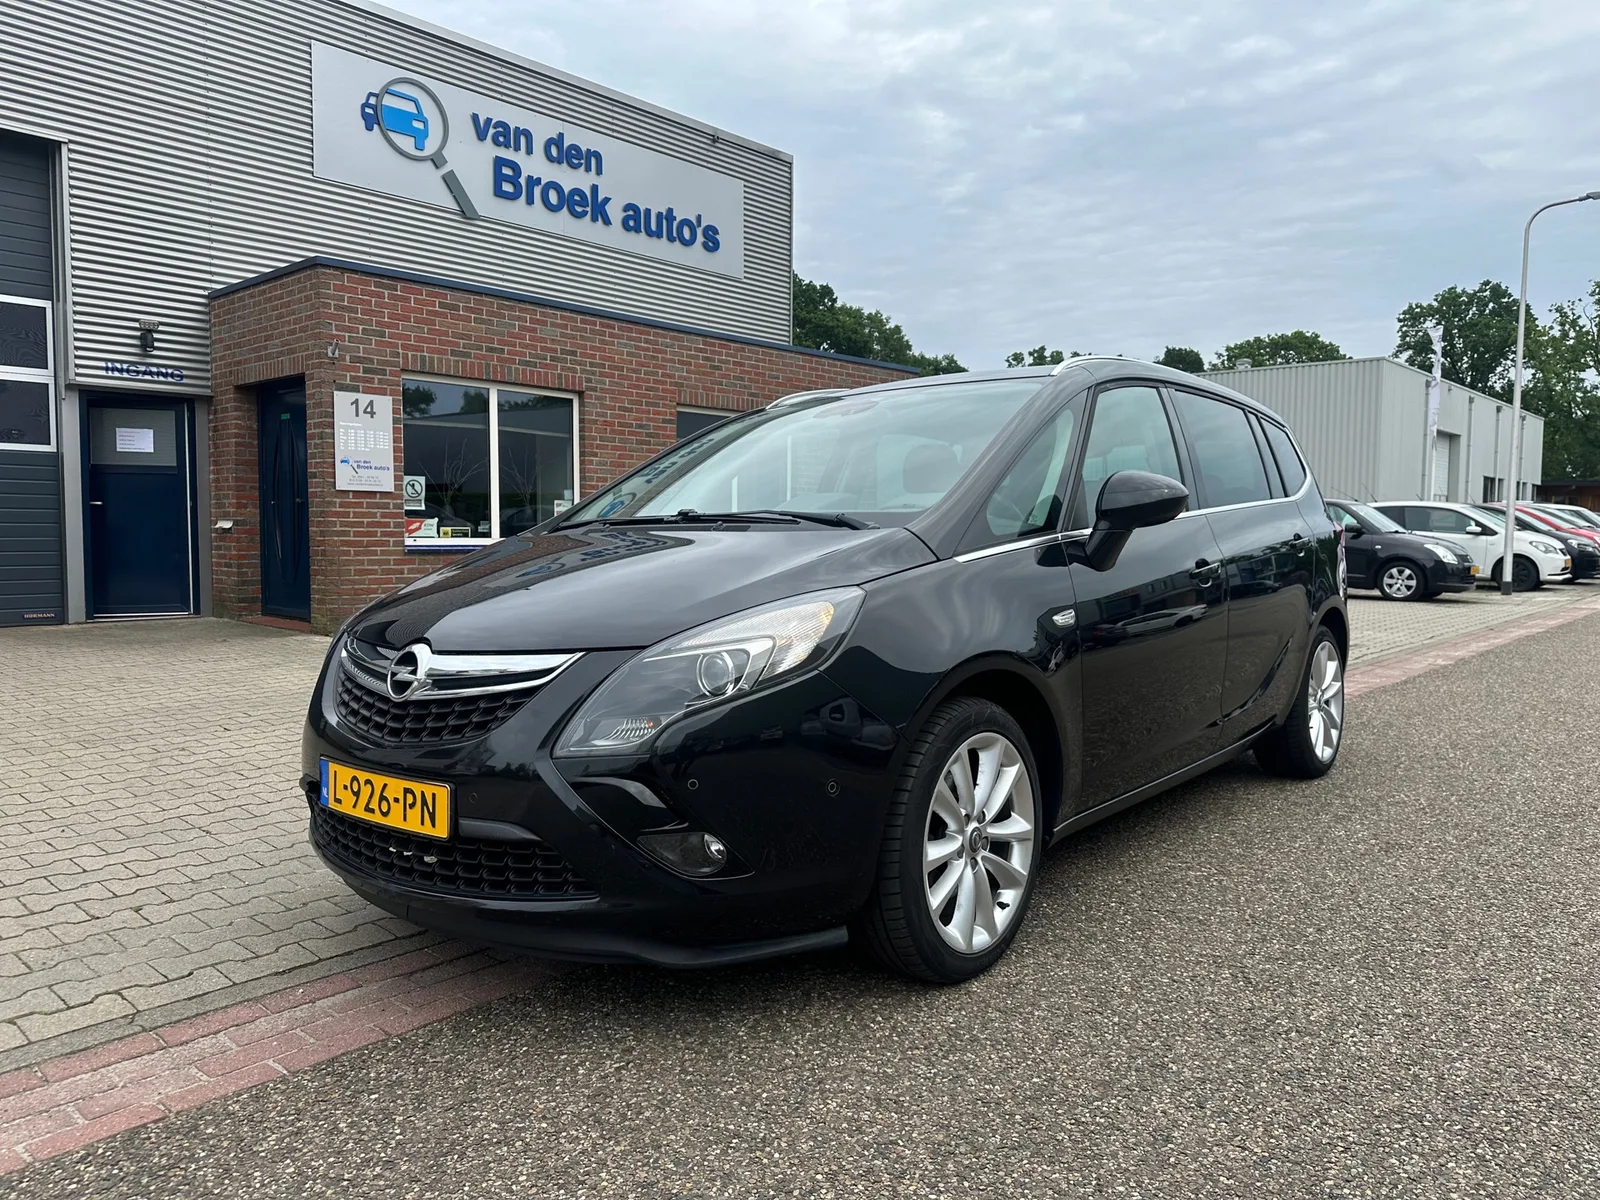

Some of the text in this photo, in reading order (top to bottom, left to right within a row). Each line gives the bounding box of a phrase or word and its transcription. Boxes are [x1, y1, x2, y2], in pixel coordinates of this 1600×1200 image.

[471, 112, 603, 176] van den
[493, 155, 720, 252] Broek auto's
[104, 361, 184, 382] INGANG
[350, 397, 376, 419] 14
[322, 787, 329, 798] NL
[333, 769, 437, 829] L-926-PN
